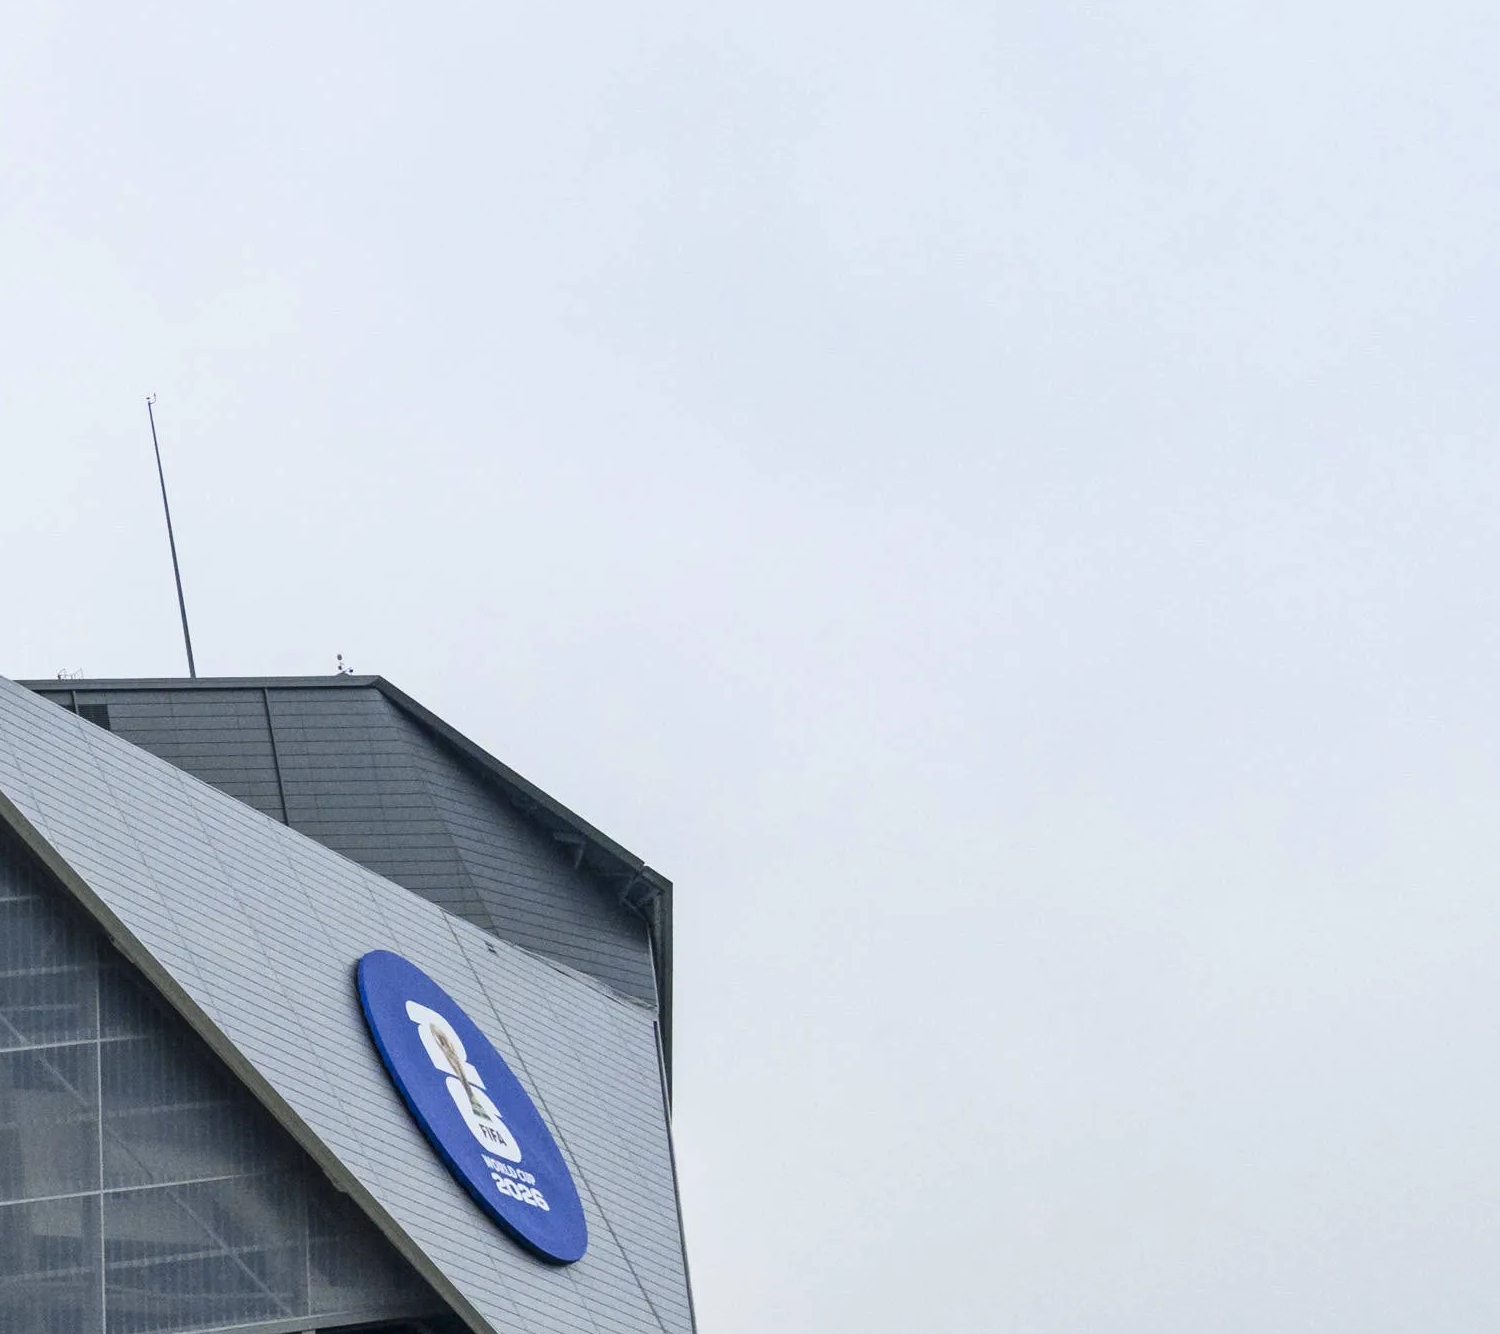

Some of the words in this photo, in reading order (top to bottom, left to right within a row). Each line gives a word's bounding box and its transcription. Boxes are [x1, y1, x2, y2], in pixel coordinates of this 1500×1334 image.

[479, 1123, 507, 1147] FIFA
[481, 1153, 514, 1181] WORLD
[515, 1168, 536, 1187] CUP
[491, 1172, 550, 1212] 2026
